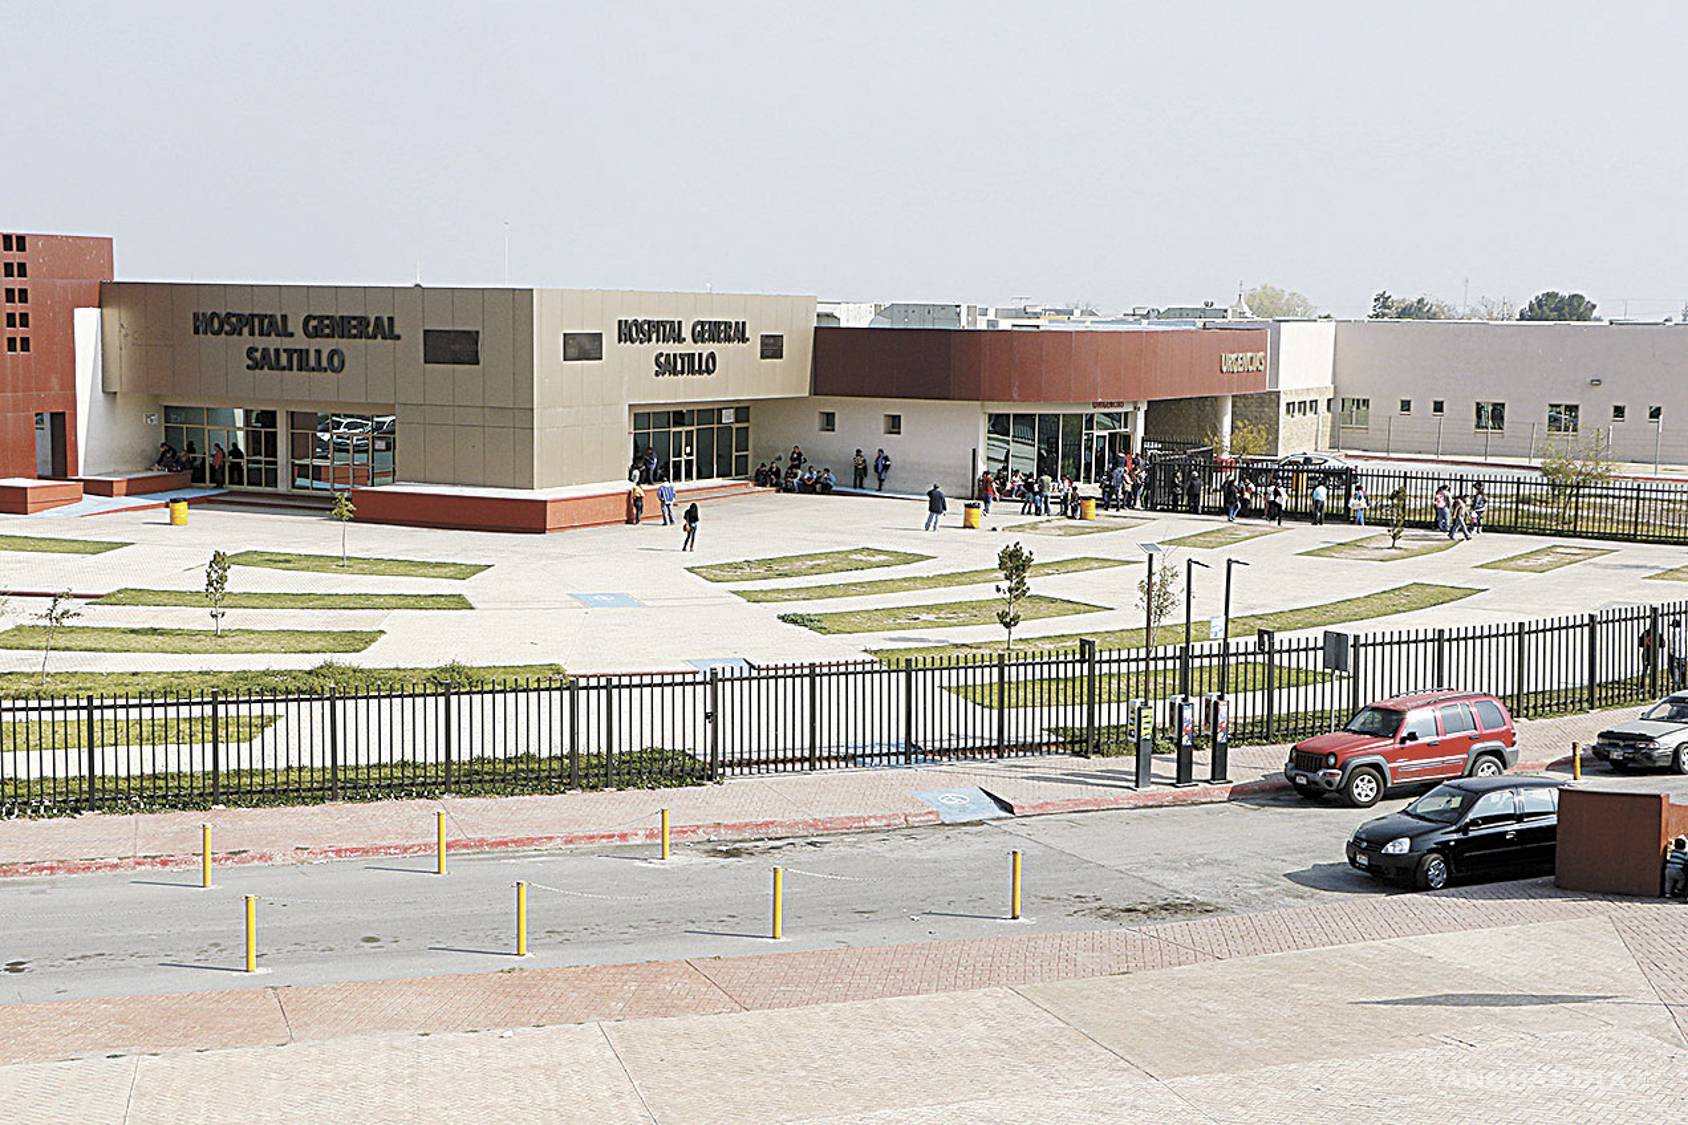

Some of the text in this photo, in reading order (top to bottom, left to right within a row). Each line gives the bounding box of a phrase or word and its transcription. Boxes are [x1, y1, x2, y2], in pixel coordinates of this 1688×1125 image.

[192, 311, 402, 341] HOSPITAL GENERAL
[617, 318, 751, 344] HOSPITAL GENERAL
[245, 346, 346, 374] SALTILLO
[654, 351, 718, 377] SALTILLO
[1219, 352, 1265, 374] URGENCIAS
